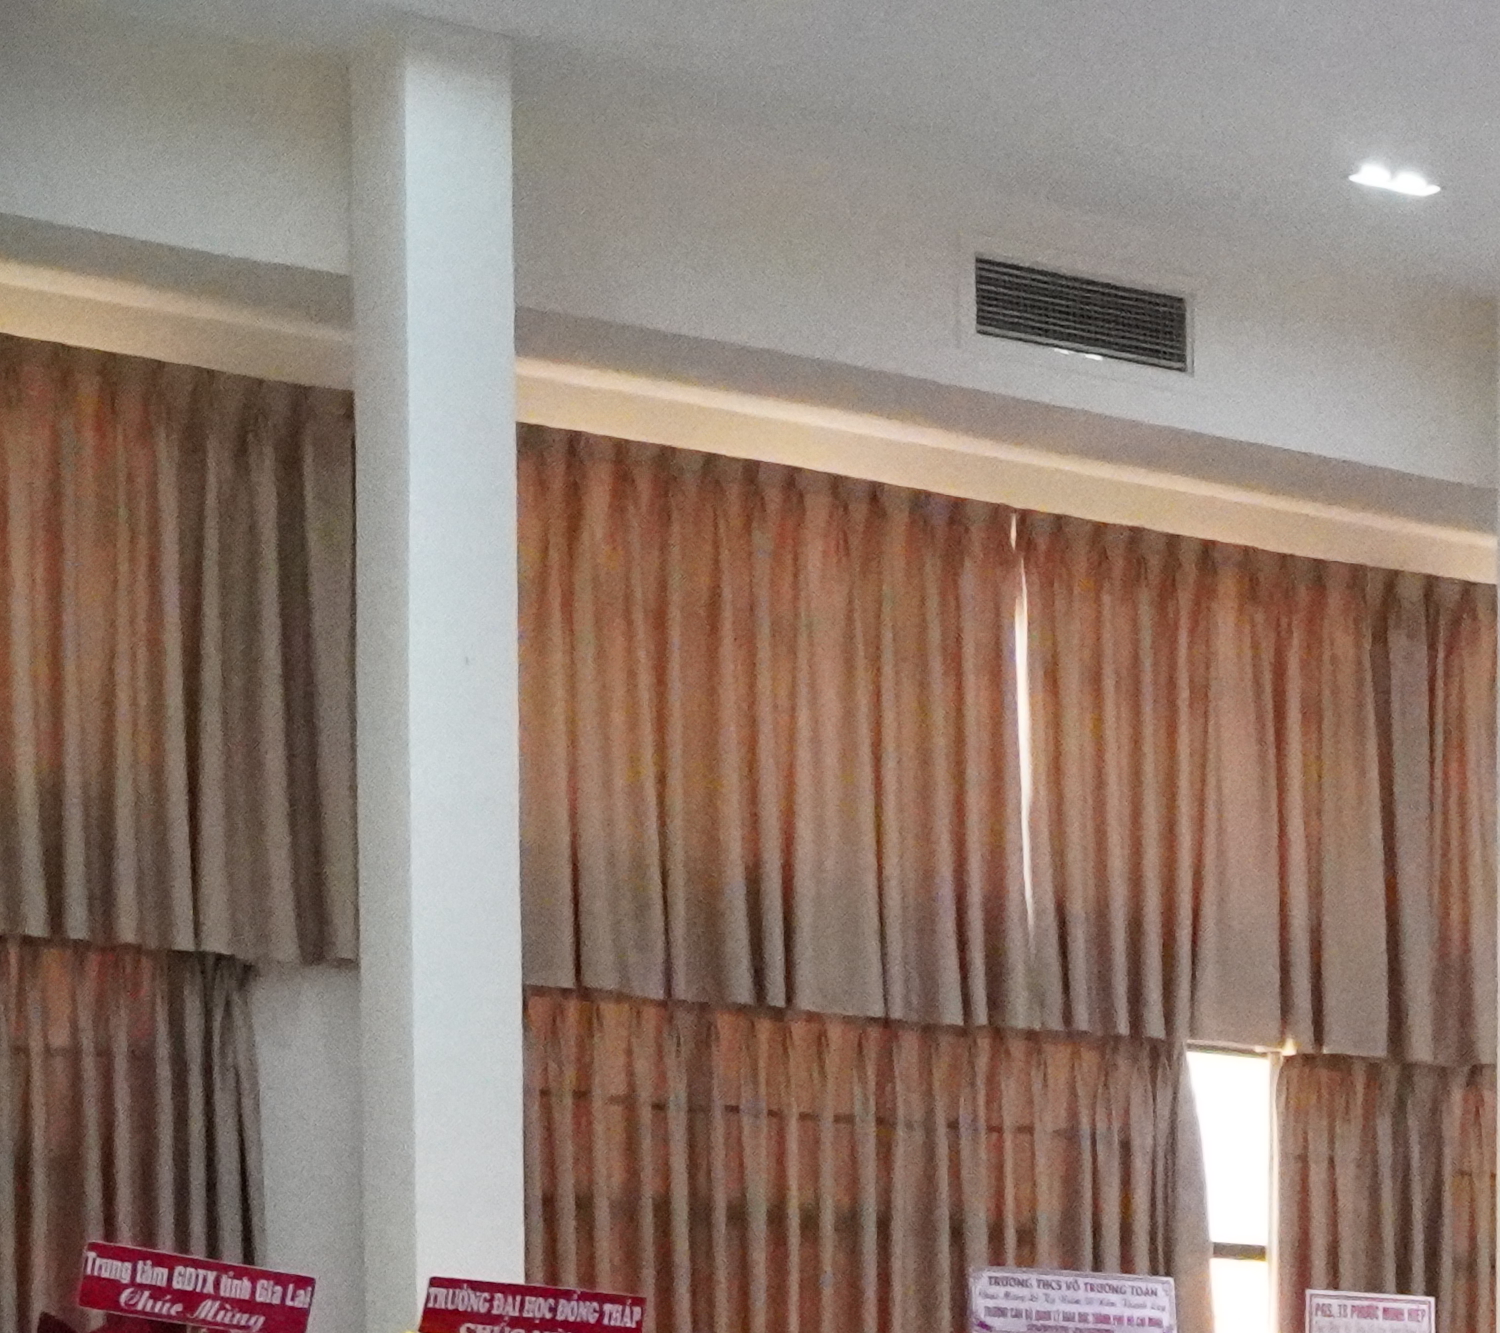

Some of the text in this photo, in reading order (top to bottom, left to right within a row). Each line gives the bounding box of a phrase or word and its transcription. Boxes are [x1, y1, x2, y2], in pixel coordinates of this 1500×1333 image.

[86, 1251, 132, 1283] Trung
[135, 1260, 169, 1287] tâm
[172, 1265, 217, 1294] GDTX
[255, 1279, 283, 1305] Gia
[285, 1283, 312, 1308] Lai
[118, 1288, 266, 1333] Chúc Mừng
[427, 1283, 642, 1328] TRƯỜNG ĐẠI HỌC ĐỒNG THÁP
